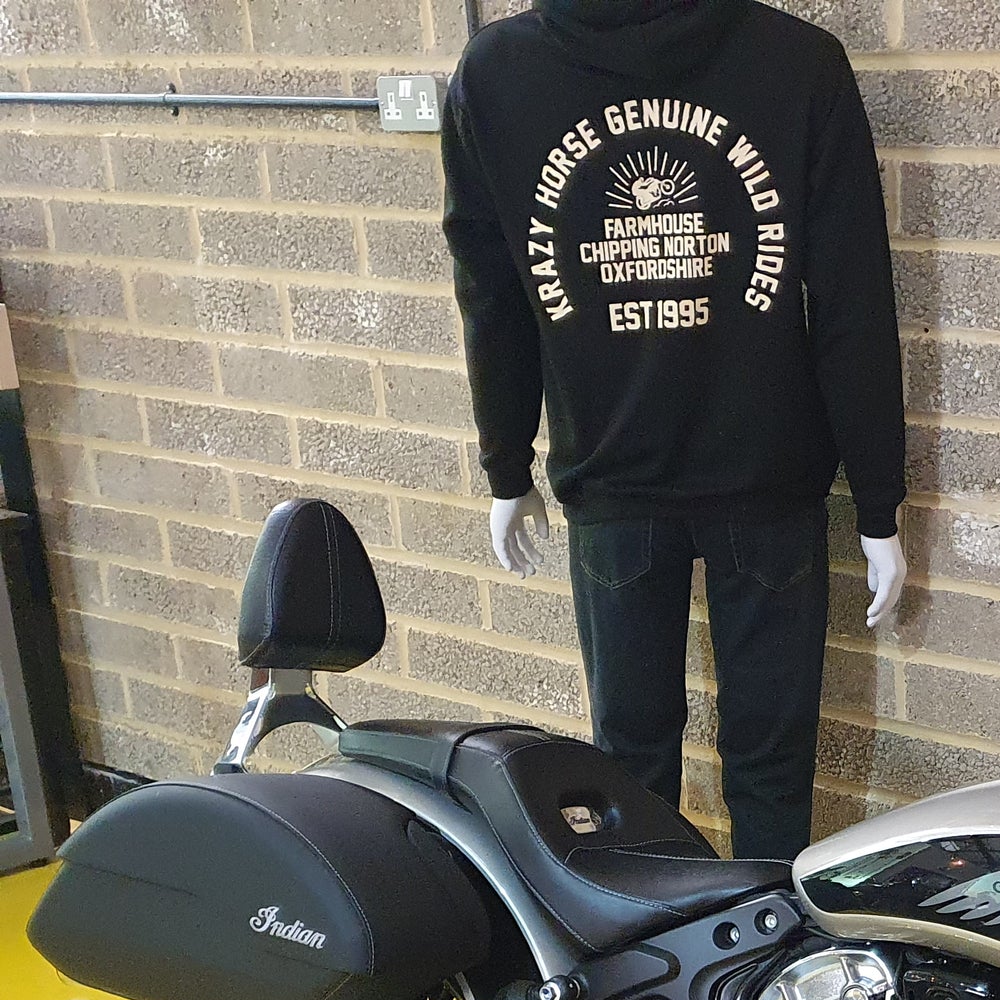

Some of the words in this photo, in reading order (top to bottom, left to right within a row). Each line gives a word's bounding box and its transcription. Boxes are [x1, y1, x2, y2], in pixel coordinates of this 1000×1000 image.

[603, 98, 729, 147] GENUINE
[534, 118, 602, 210] HORSE
[726, 134, 780, 213] WILD
[579, 236, 661, 264] CHIPPING
[663, 231, 730, 257] NORTON
[603, 212, 705, 240] FARMHOUSE
[527, 217, 575, 322] KRAZY
[600, 255, 714, 284] OXFORDSHIRE
[744, 222, 785, 312] RIDES
[608, 301, 654, 332] EST
[656, 296, 709, 330] 1995
[249, 905, 326, 950] Indian
